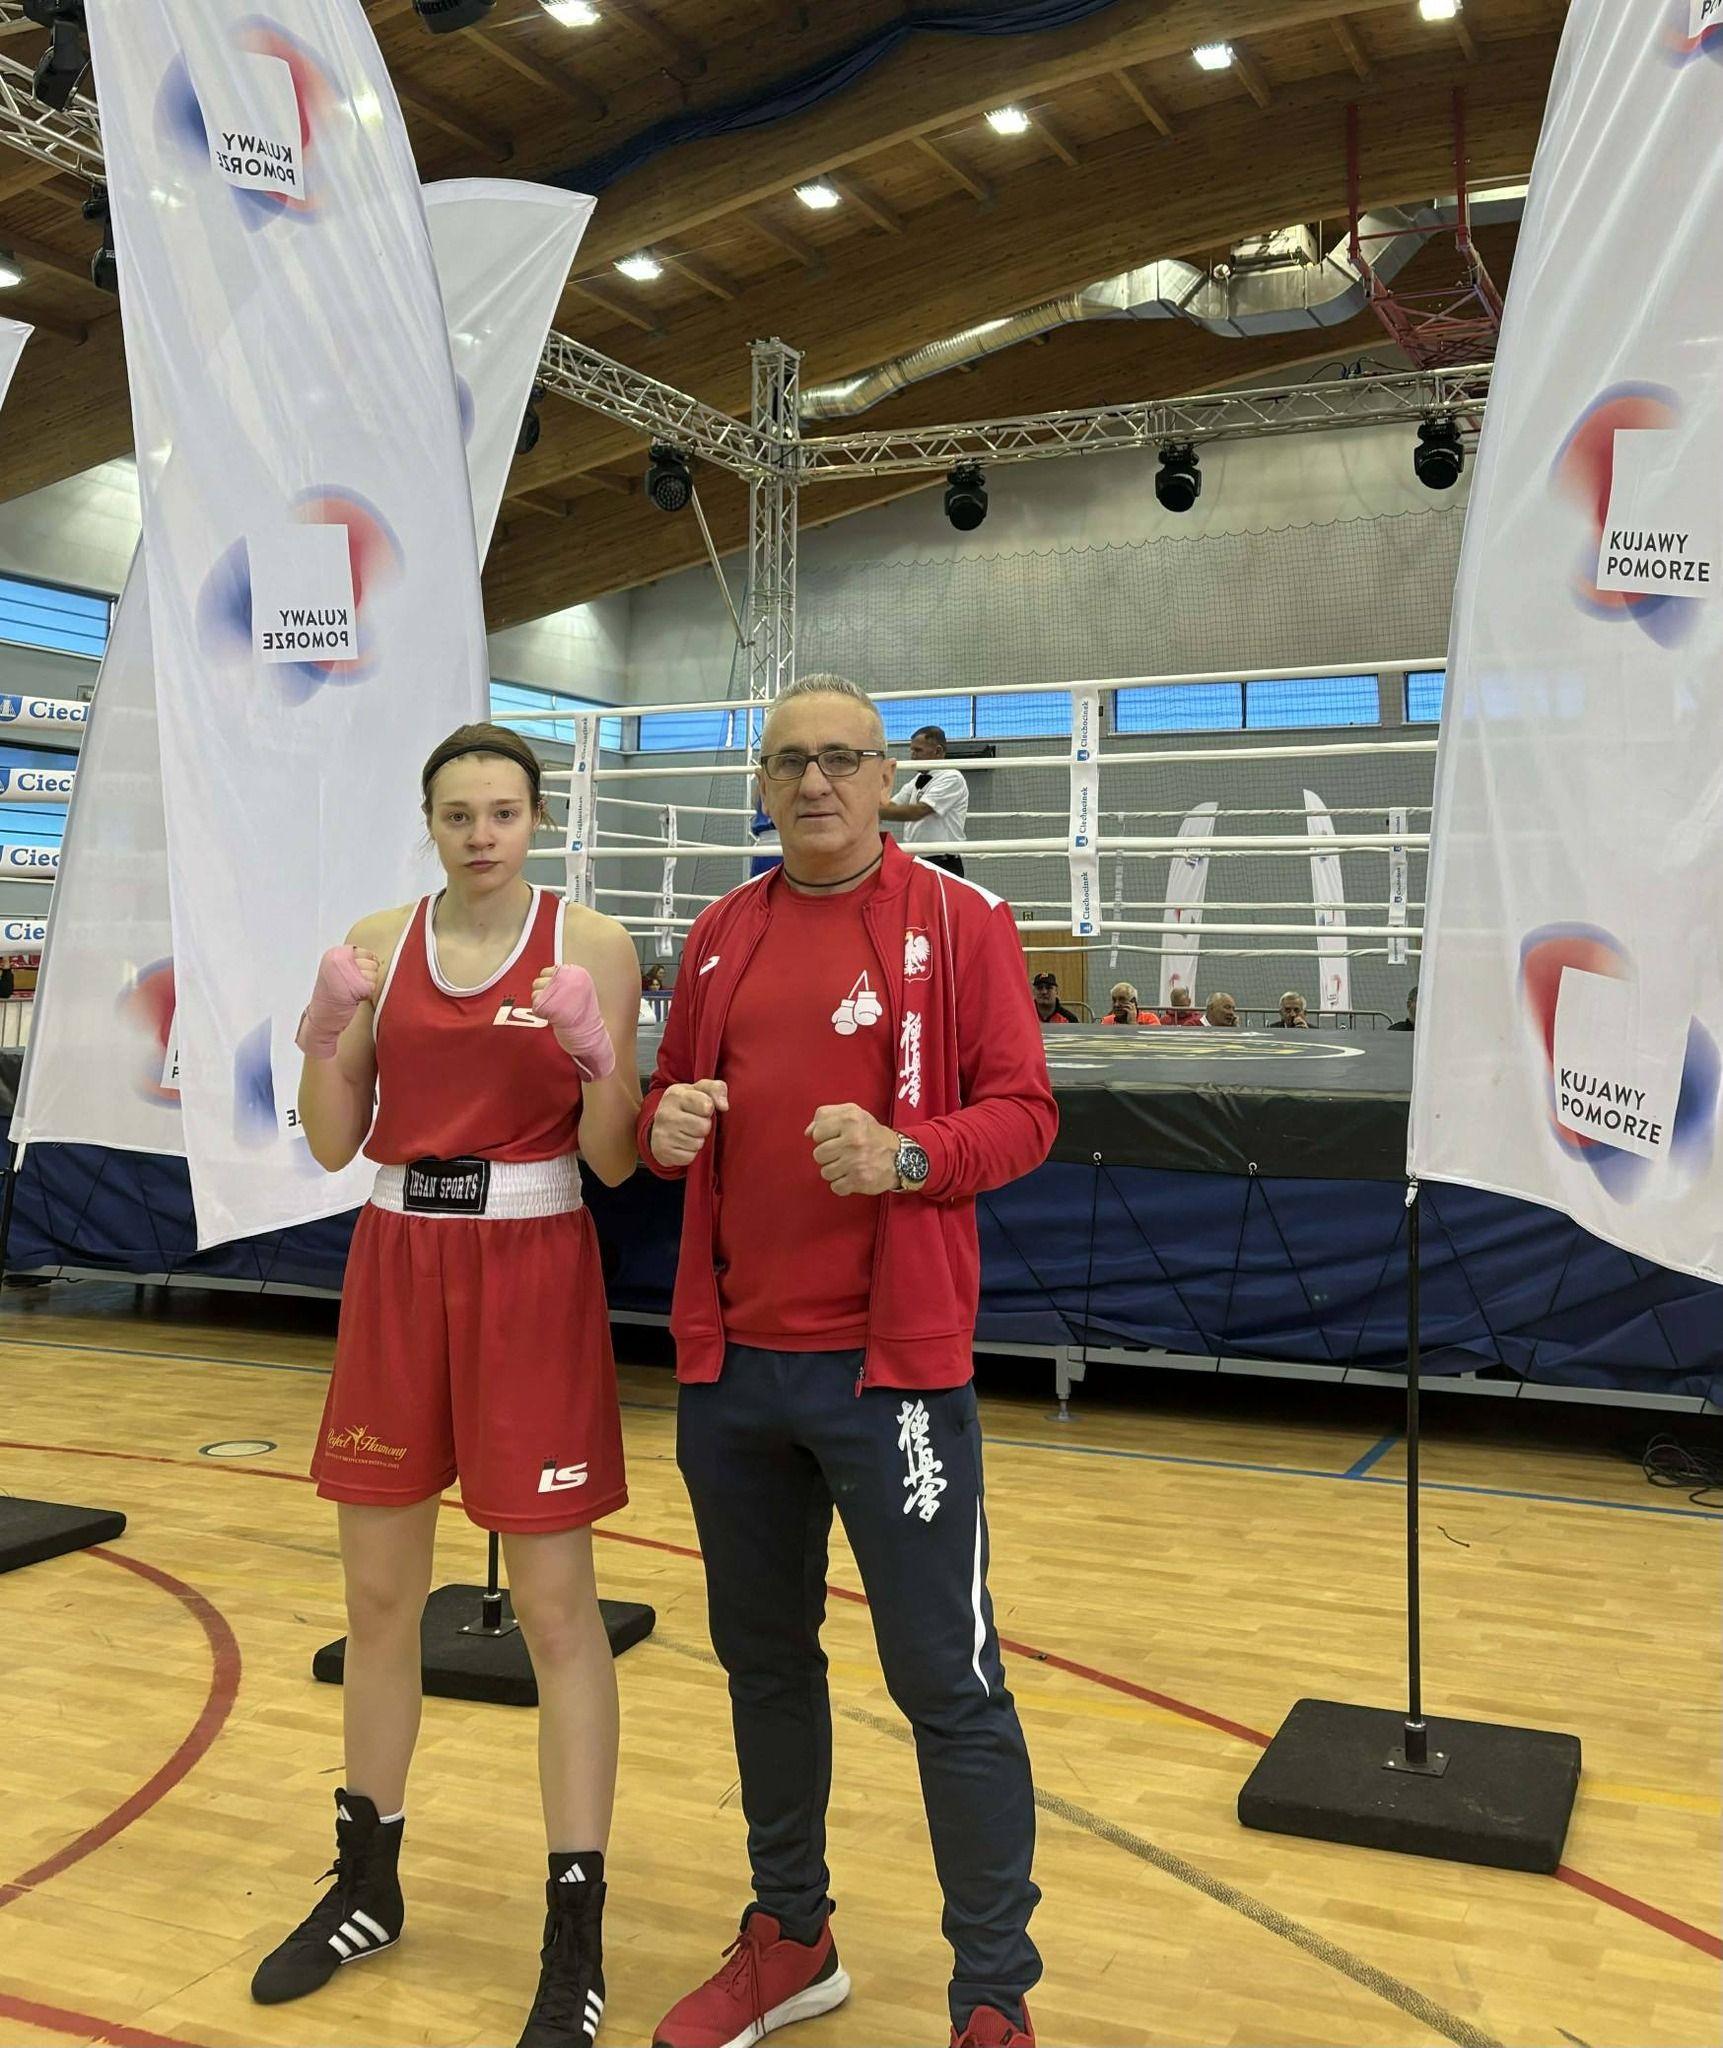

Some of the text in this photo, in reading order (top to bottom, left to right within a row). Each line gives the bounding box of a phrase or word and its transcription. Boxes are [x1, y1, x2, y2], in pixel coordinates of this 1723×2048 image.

[1609, 530, 1689, 554] KUJAWY
[1606, 556, 1710, 582] POMORZE
[17, 773, 76, 792] Ciec
[1080, 786, 1088, 834] Ciechocinek
[1082, 871, 1090, 920] Ciechocinek
[1561, 1067, 1646, 1111] KUJAWY
[1561, 1092, 1662, 1145] POMORZE
[409, 1169, 479, 1200] IHSAN SPORTS
